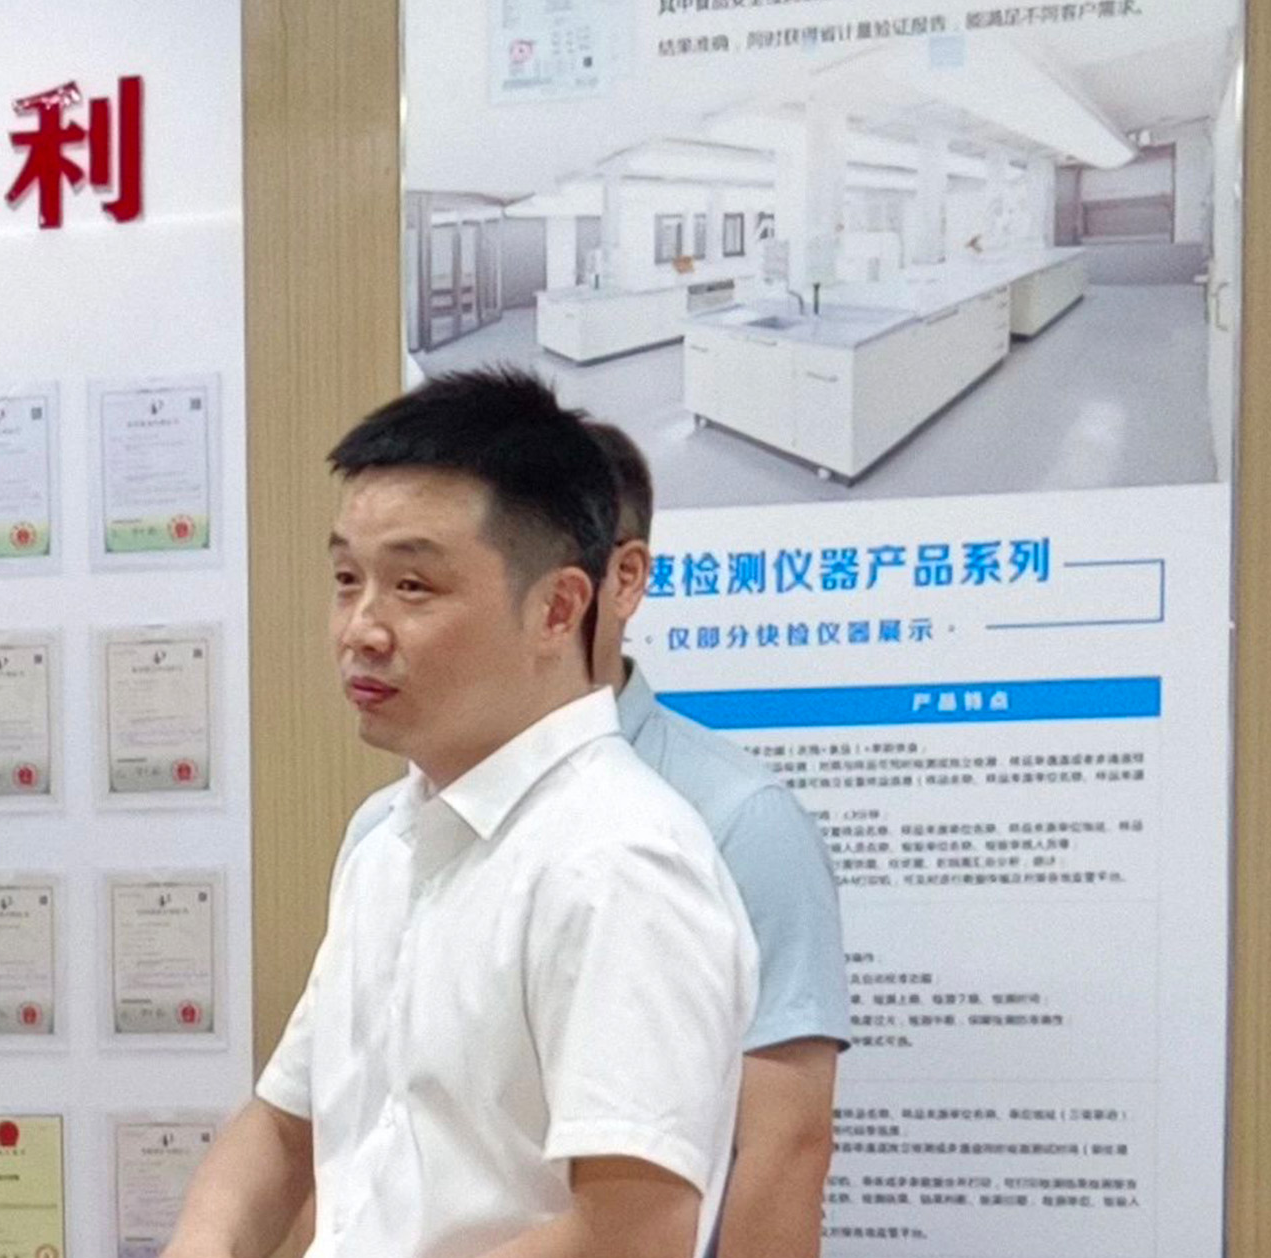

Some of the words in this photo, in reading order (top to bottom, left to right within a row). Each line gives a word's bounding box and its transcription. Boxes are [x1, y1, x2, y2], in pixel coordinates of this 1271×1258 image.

[667, 618, 933, 651] 仅部分快检仪器展示
